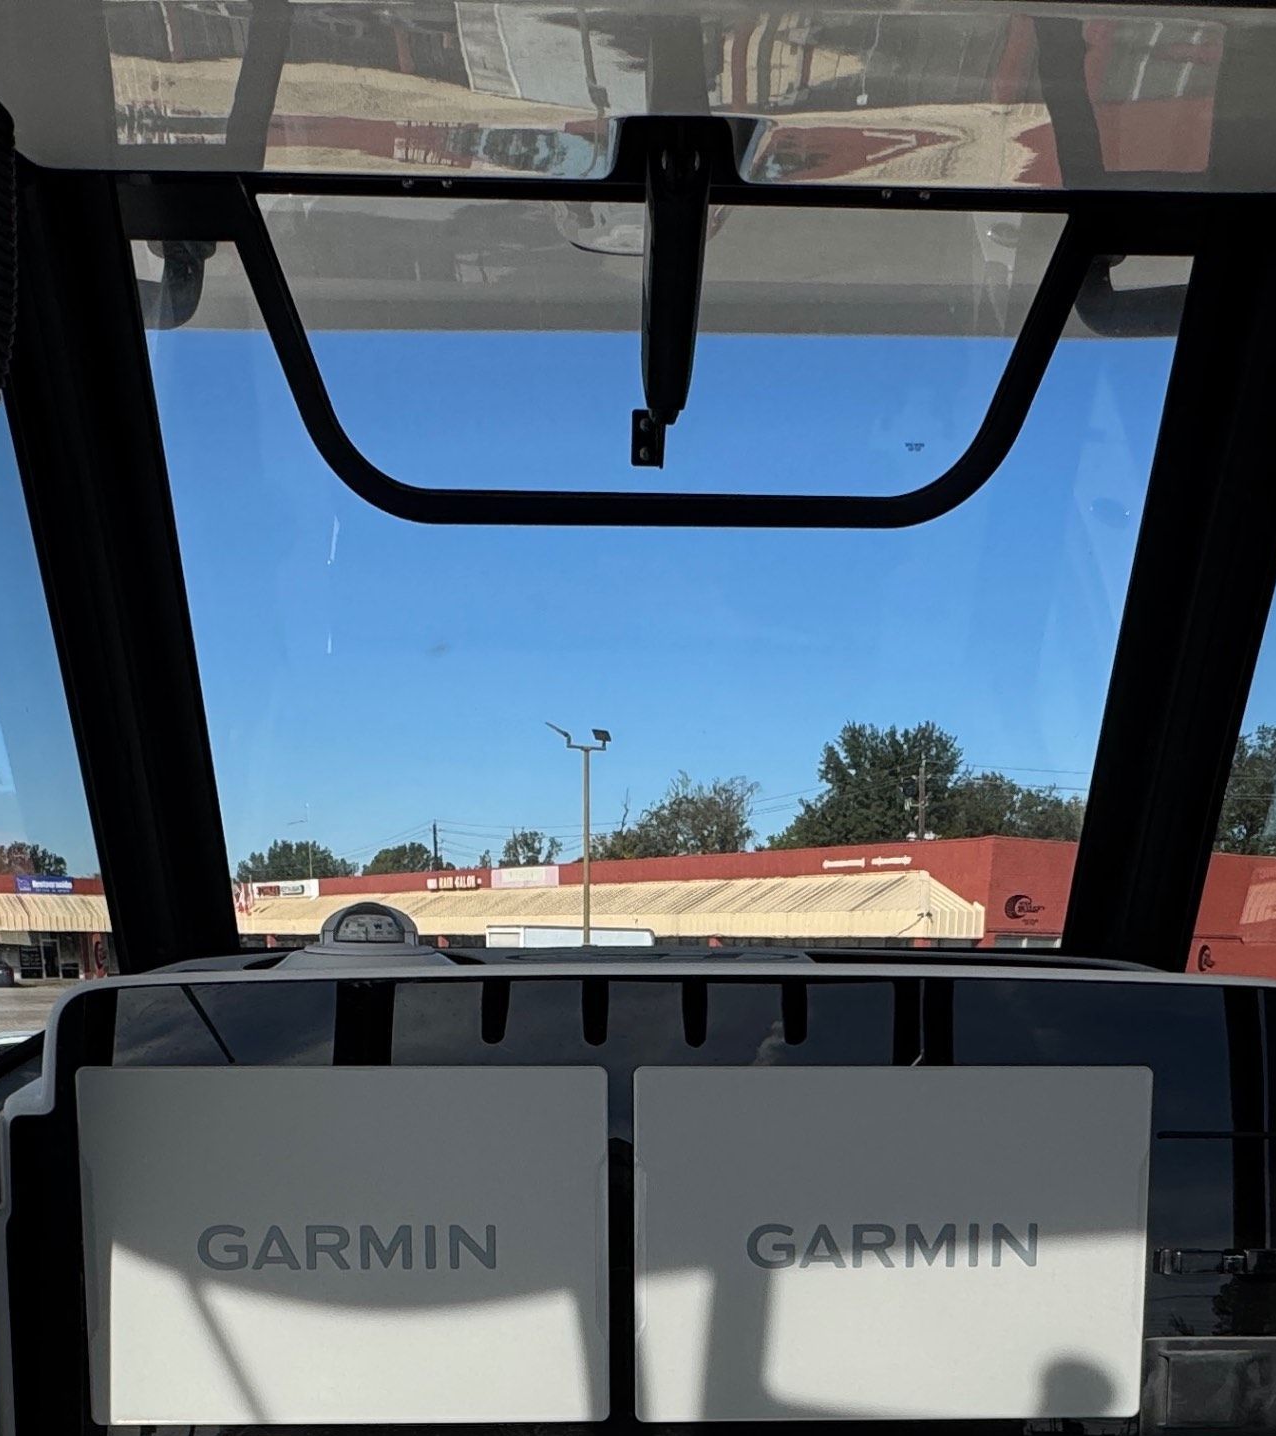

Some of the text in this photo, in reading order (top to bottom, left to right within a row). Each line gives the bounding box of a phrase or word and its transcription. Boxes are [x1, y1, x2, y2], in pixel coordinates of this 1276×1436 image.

[454, 875, 476, 888] SALON
[197, 1223, 497, 1271] GARMIN
[746, 1222, 1039, 1270] GARMIN
